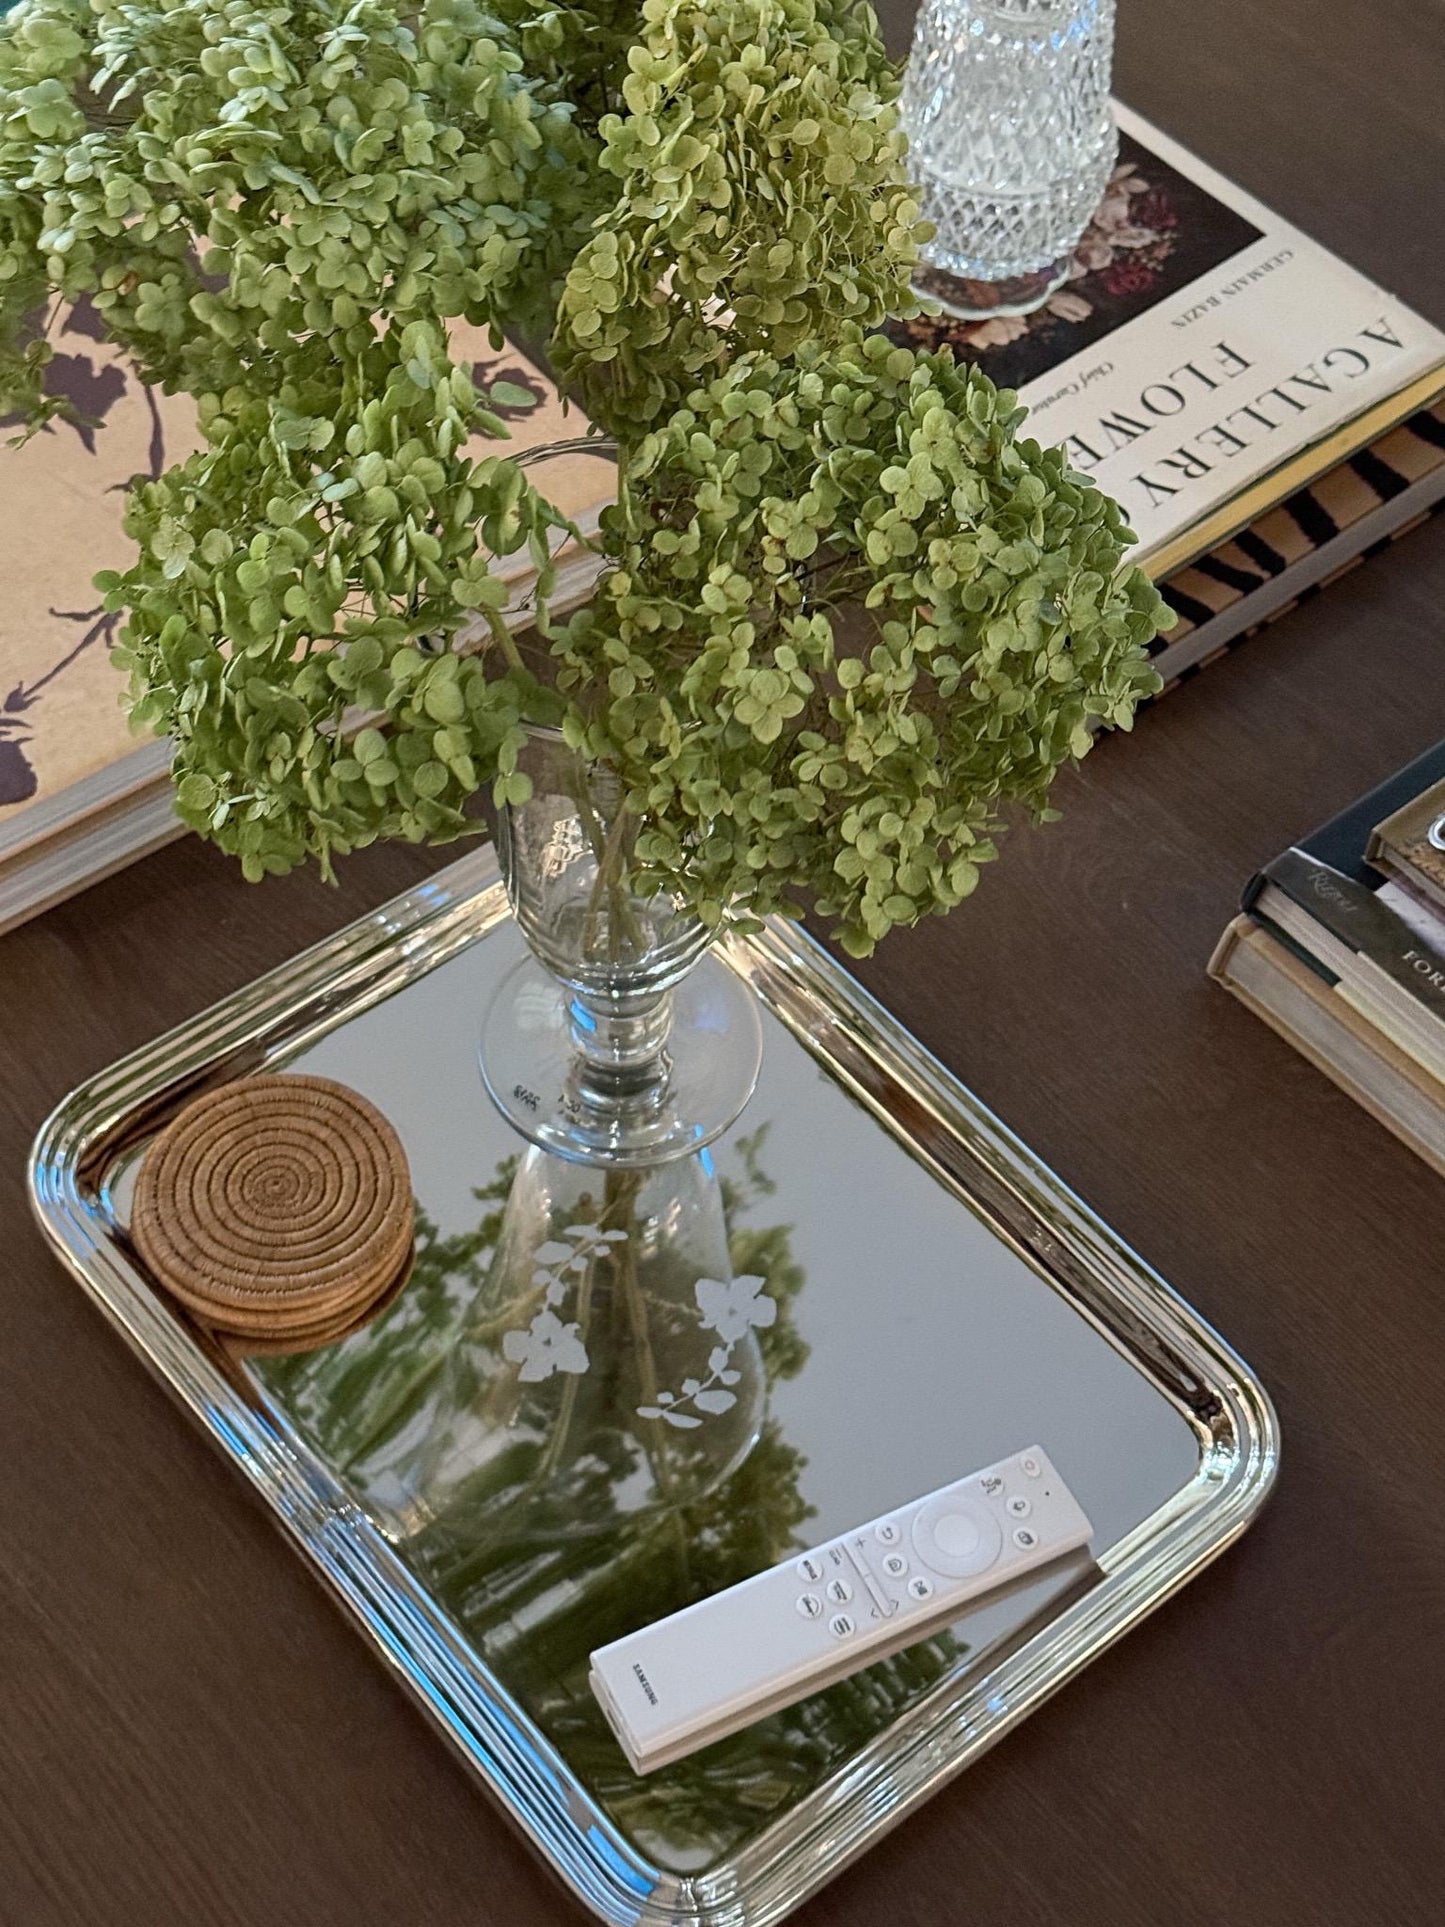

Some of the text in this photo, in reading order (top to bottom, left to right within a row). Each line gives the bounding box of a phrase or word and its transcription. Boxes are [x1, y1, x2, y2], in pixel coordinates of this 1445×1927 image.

[1171, 250, 1294, 329] GERMAIN BAZIN
[1077, 361, 1114, 390] Chief
[1130, 317, 1405, 509] A GALLERY
[1402, 950, 1445, 993] FOR
[633, 1664, 658, 1705] SAMSUNG
